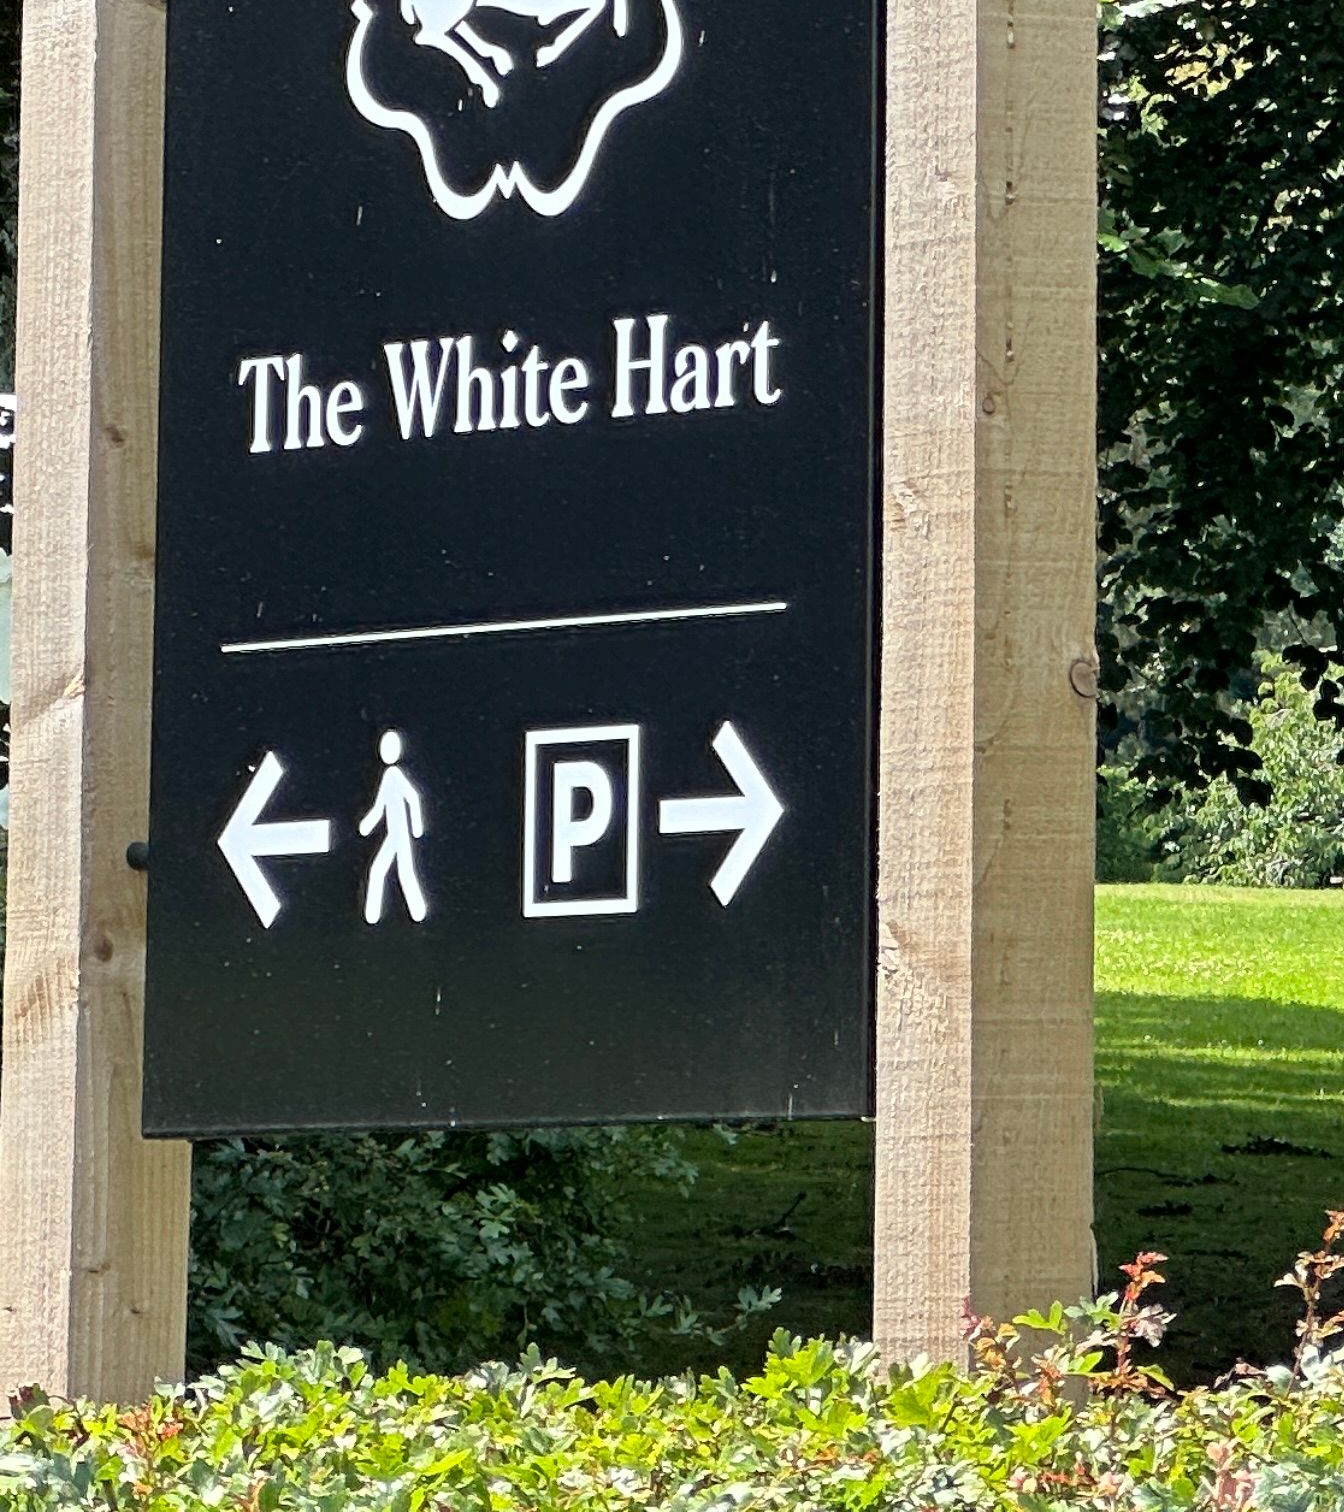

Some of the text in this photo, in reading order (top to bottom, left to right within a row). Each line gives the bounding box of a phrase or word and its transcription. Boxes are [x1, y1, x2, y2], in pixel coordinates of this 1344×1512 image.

[238, 315, 783, 454] The White Hart
[552, 761, 614, 883] P
